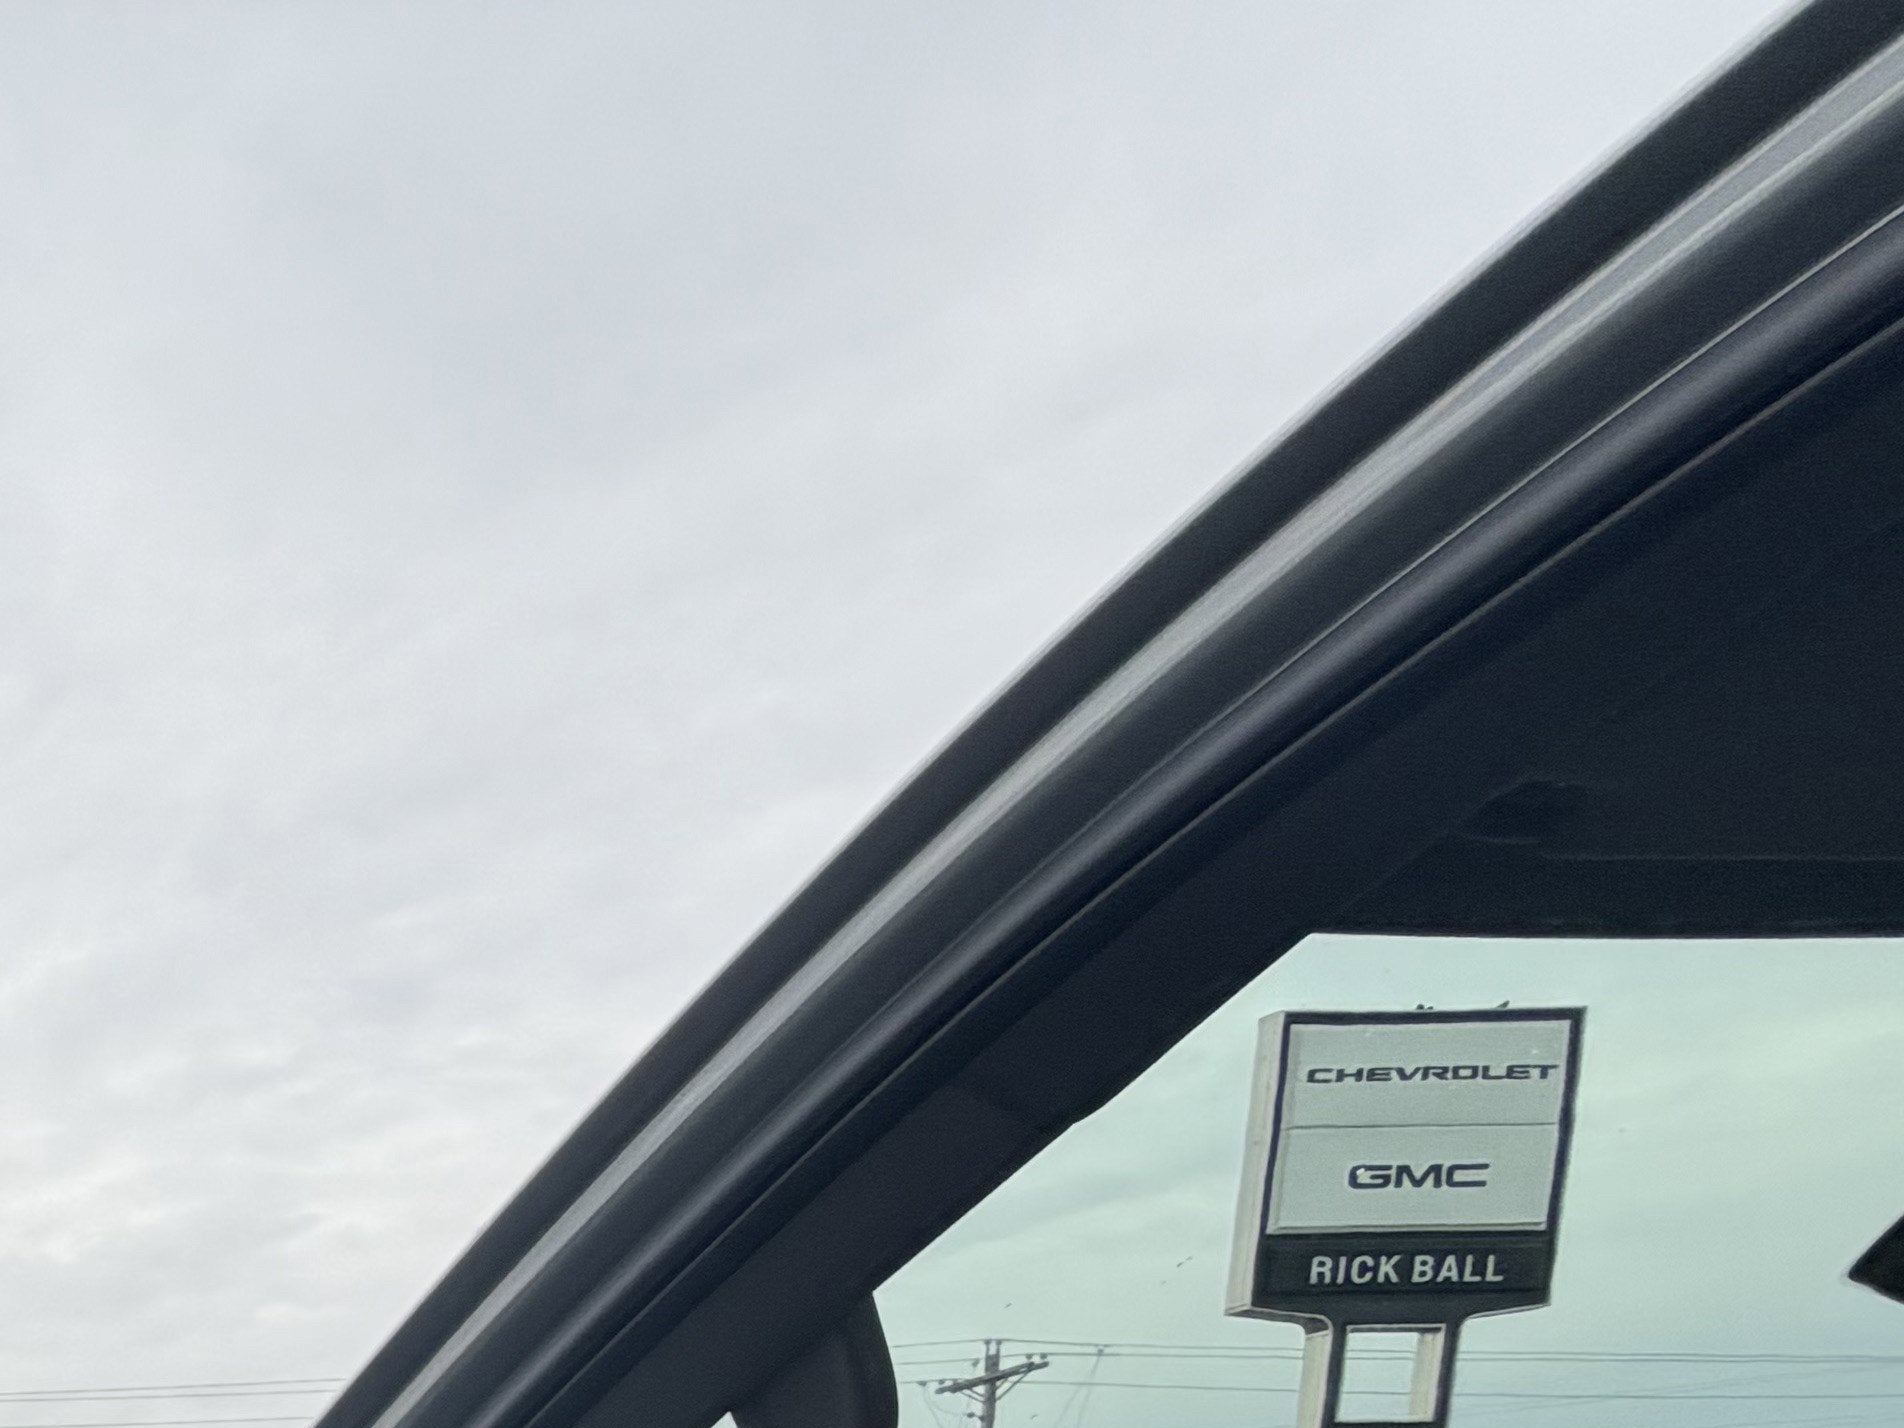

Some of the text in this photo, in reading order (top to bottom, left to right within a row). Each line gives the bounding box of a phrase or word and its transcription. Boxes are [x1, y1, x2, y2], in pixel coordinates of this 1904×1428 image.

[1305, 1063, 1560, 1084] CHEVROLET
[1347, 1162, 1491, 1190] GMC
[1308, 1254, 1505, 1285] RICK BALL
